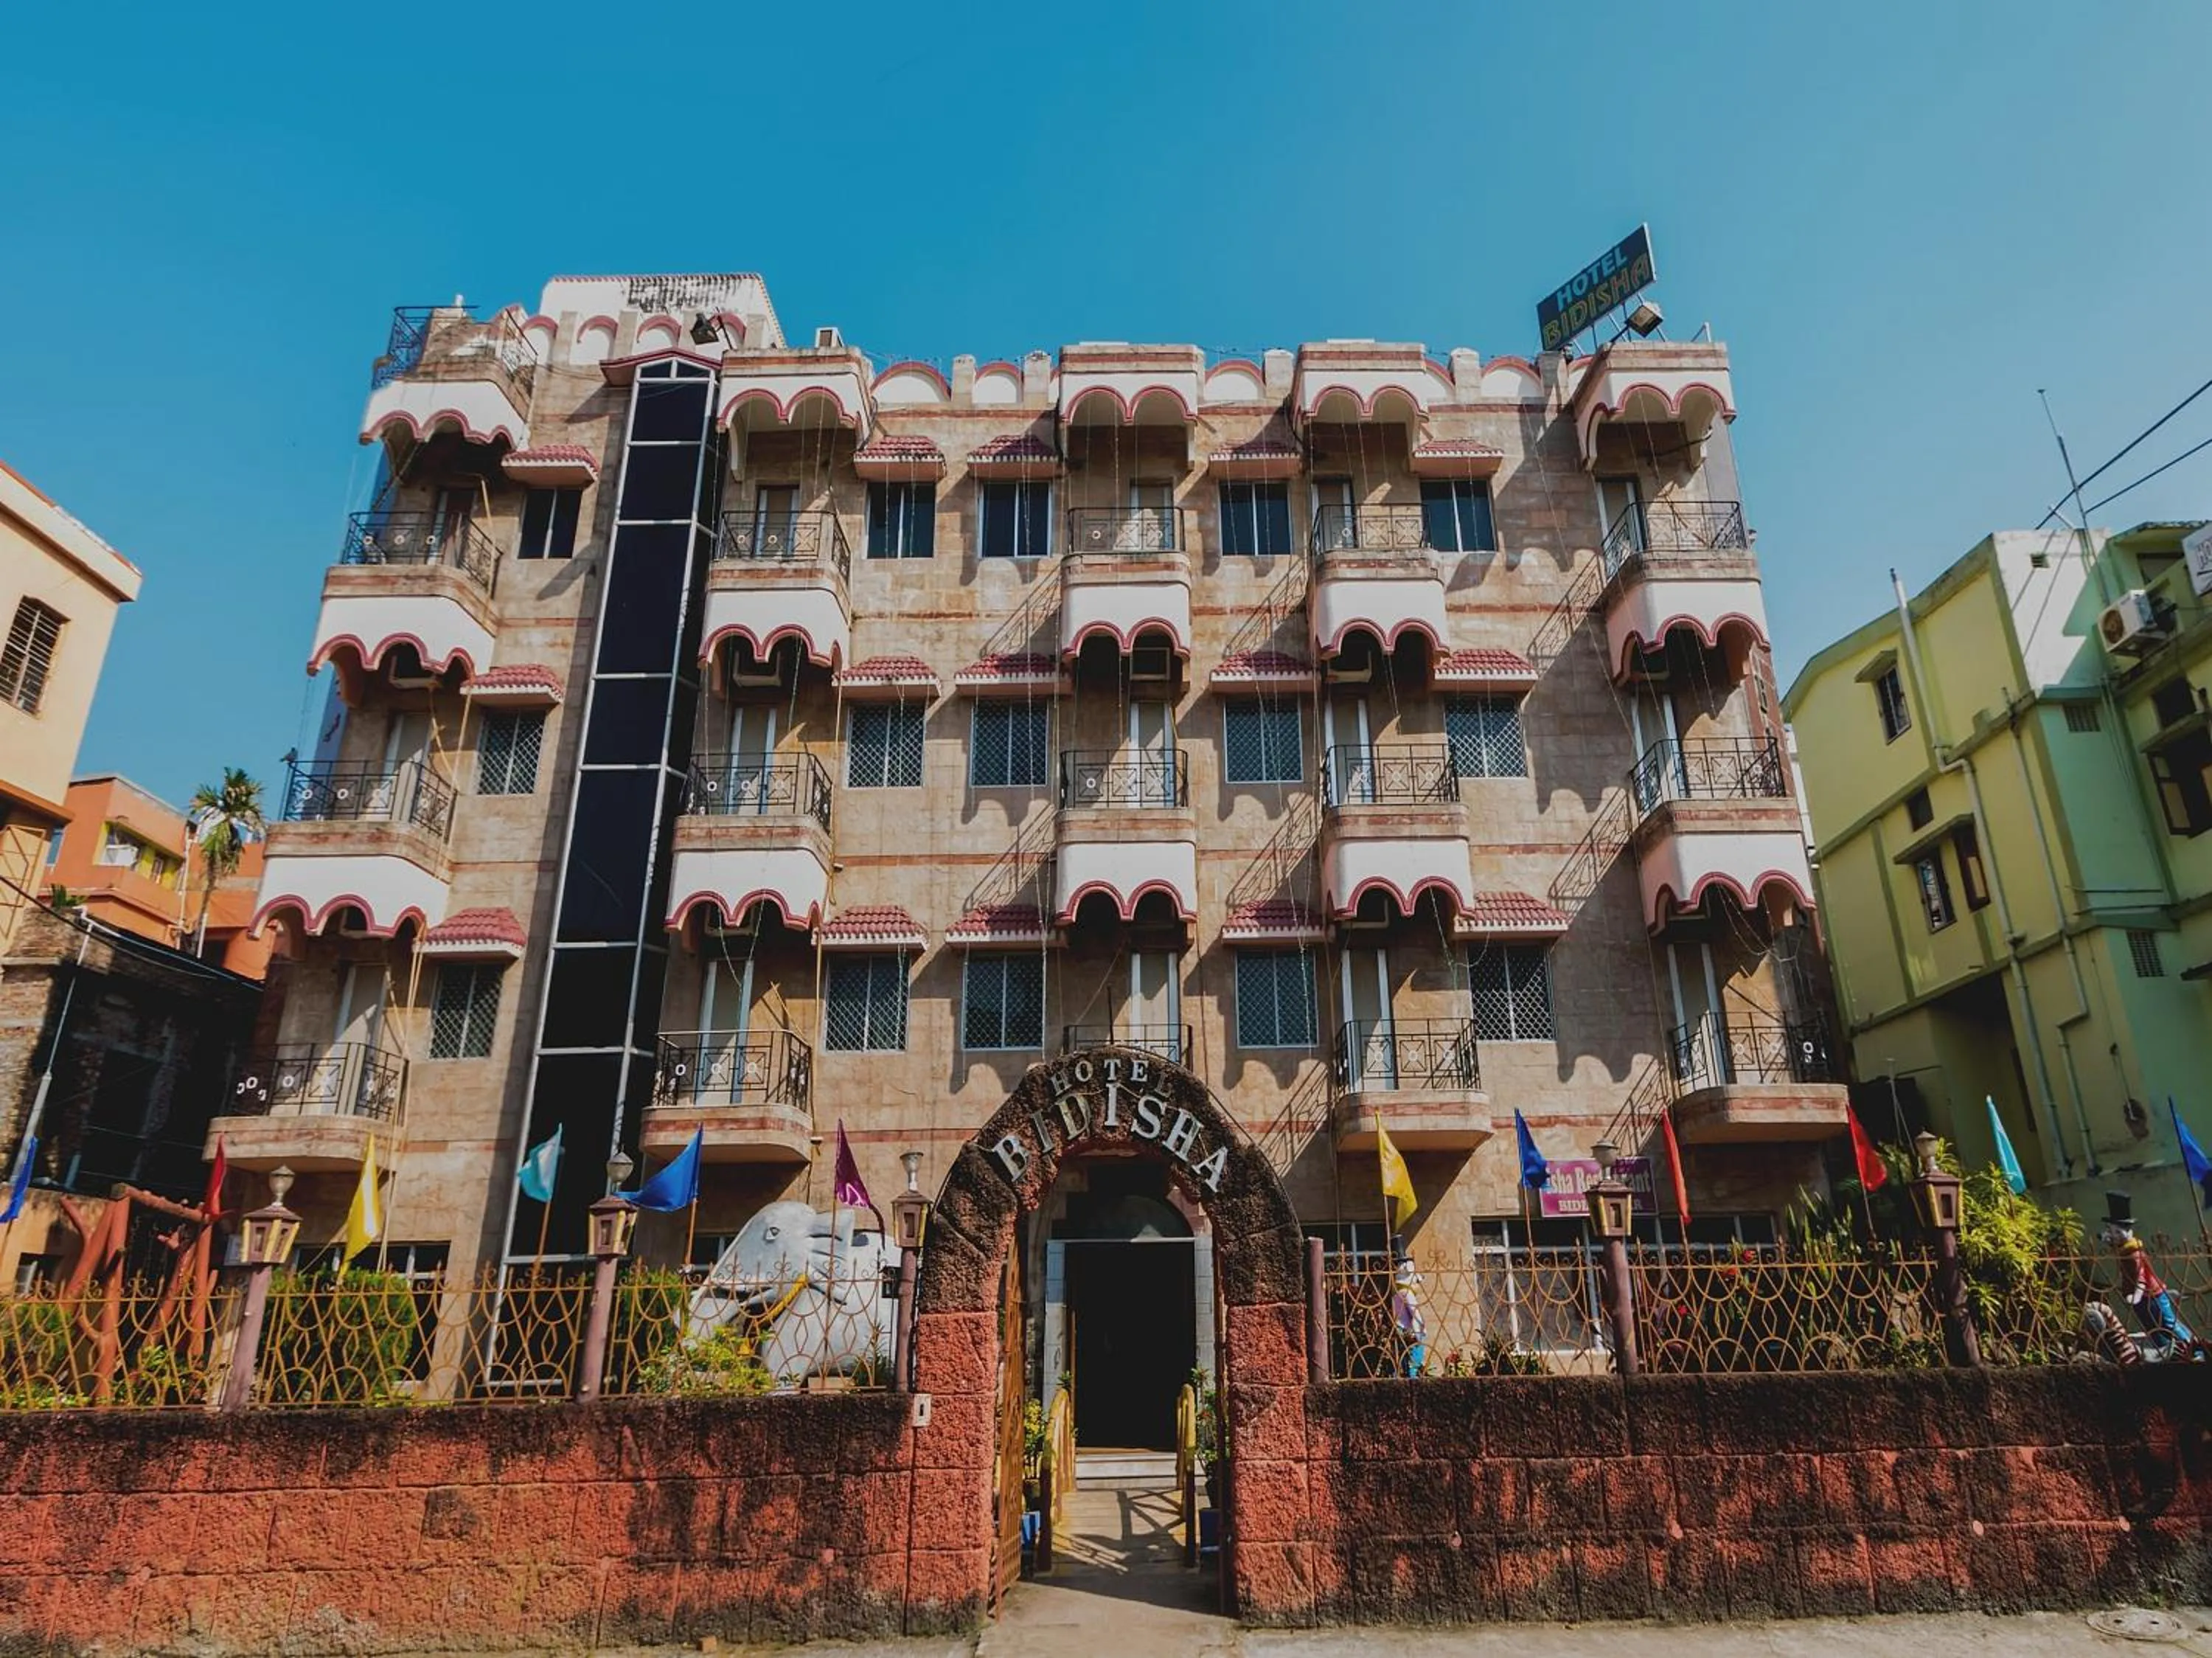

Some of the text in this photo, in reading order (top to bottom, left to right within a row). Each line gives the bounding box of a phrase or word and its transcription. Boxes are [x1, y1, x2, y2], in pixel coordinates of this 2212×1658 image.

[1543, 252, 1650, 350] BIDISHA
[1555, 247, 1628, 311] HOTEL
[1050, 1058, 1172, 1098] HOTEL
[991, 1083, 1228, 1193] BIDISHA
[1545, 1167, 1652, 1194] isha Restrant
